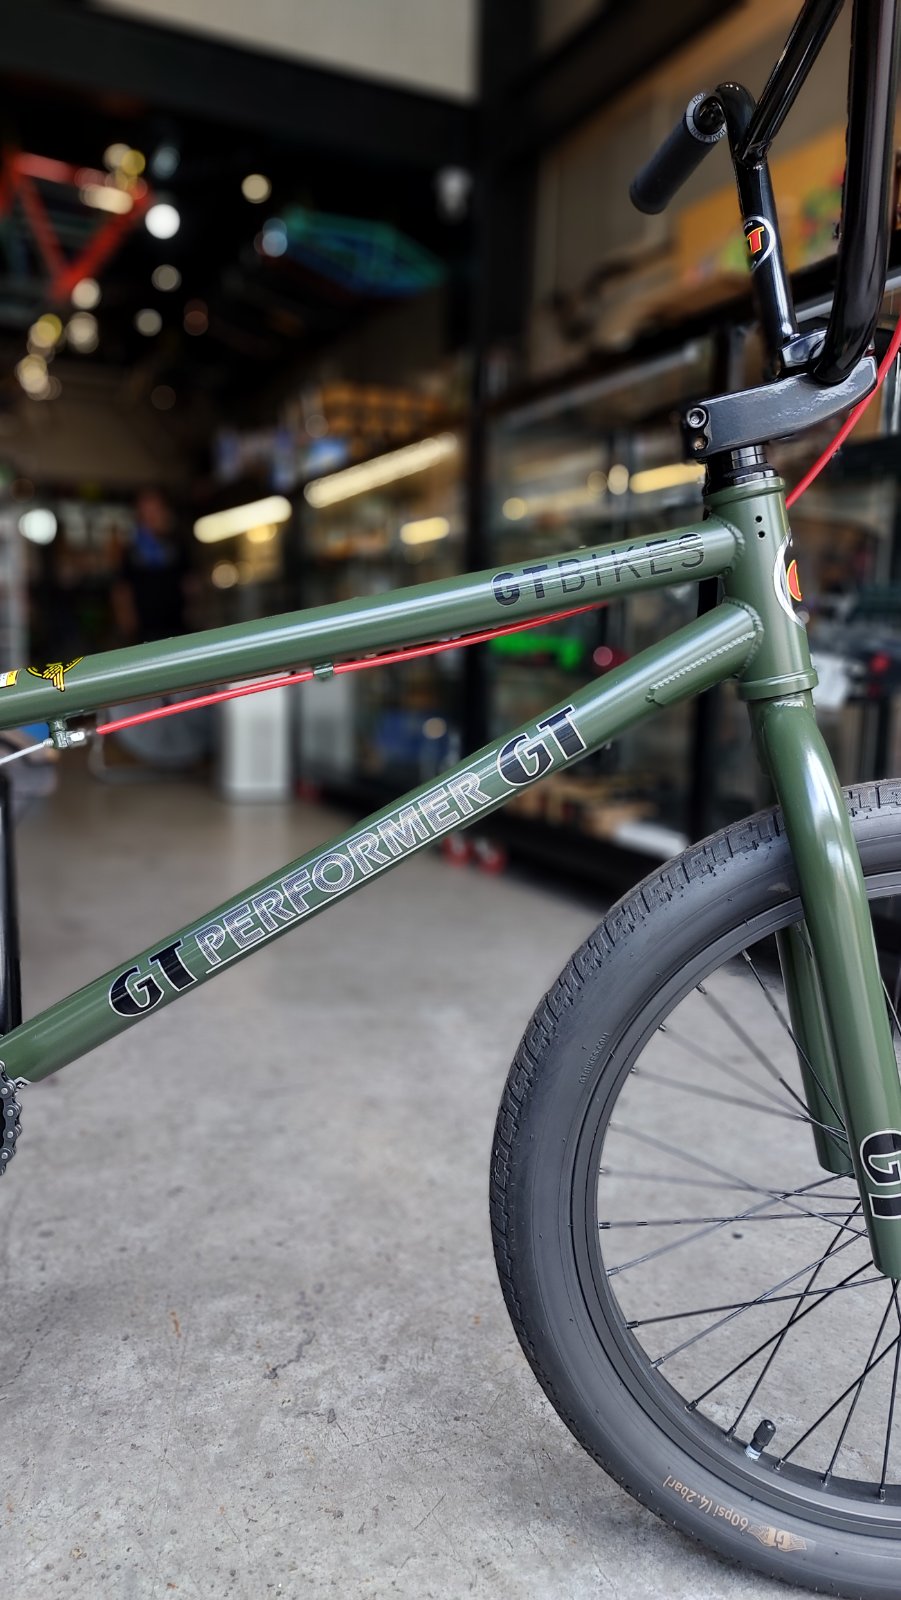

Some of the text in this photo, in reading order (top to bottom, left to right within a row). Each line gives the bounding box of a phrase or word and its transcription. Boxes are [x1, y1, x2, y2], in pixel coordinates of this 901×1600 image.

[108, 703, 588, 1017] GT PERFORMER GT
[662, 1475, 713, 1513] (4.2bar)
[713, 1503, 749, 1532] 60psi
